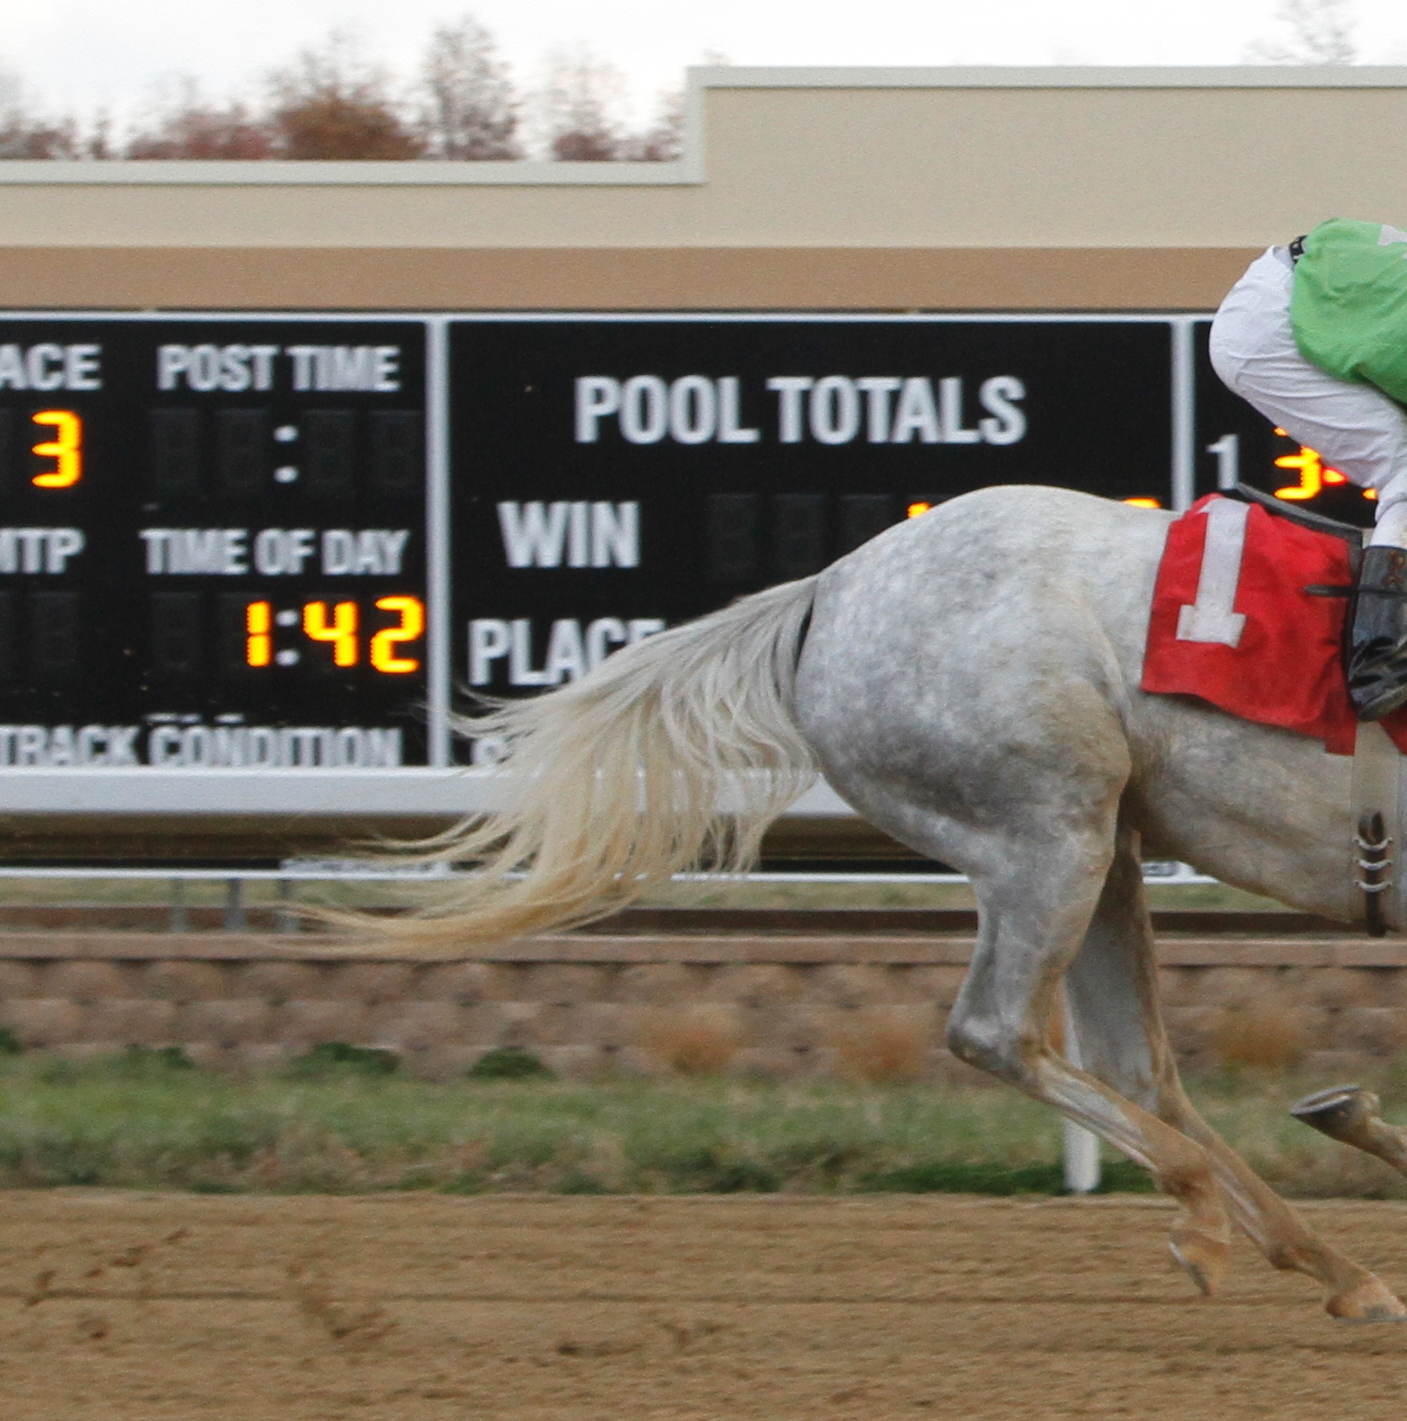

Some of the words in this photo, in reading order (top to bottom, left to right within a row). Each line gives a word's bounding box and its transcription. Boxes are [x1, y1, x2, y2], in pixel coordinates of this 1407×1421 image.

[158, 344, 279, 391] POST
[285, 344, 400, 391] TIME
[576, 375, 760, 445] POOL
[767, 375, 1026, 445] TOTALS
[31, 410, 82, 488] 3
[1208, 435, 1241, 490] 1
[140, 529, 248, 575] TIME
[255, 529, 315, 575] OF
[321, 529, 409, 575] DAY
[498, 501, 639, 567] WIN
[1176, 498, 1250, 648] 1
[246, 597, 424, 673] 1:42
[0, 725, 140, 765] TRACK
[149, 726, 400, 765] CONDITION
